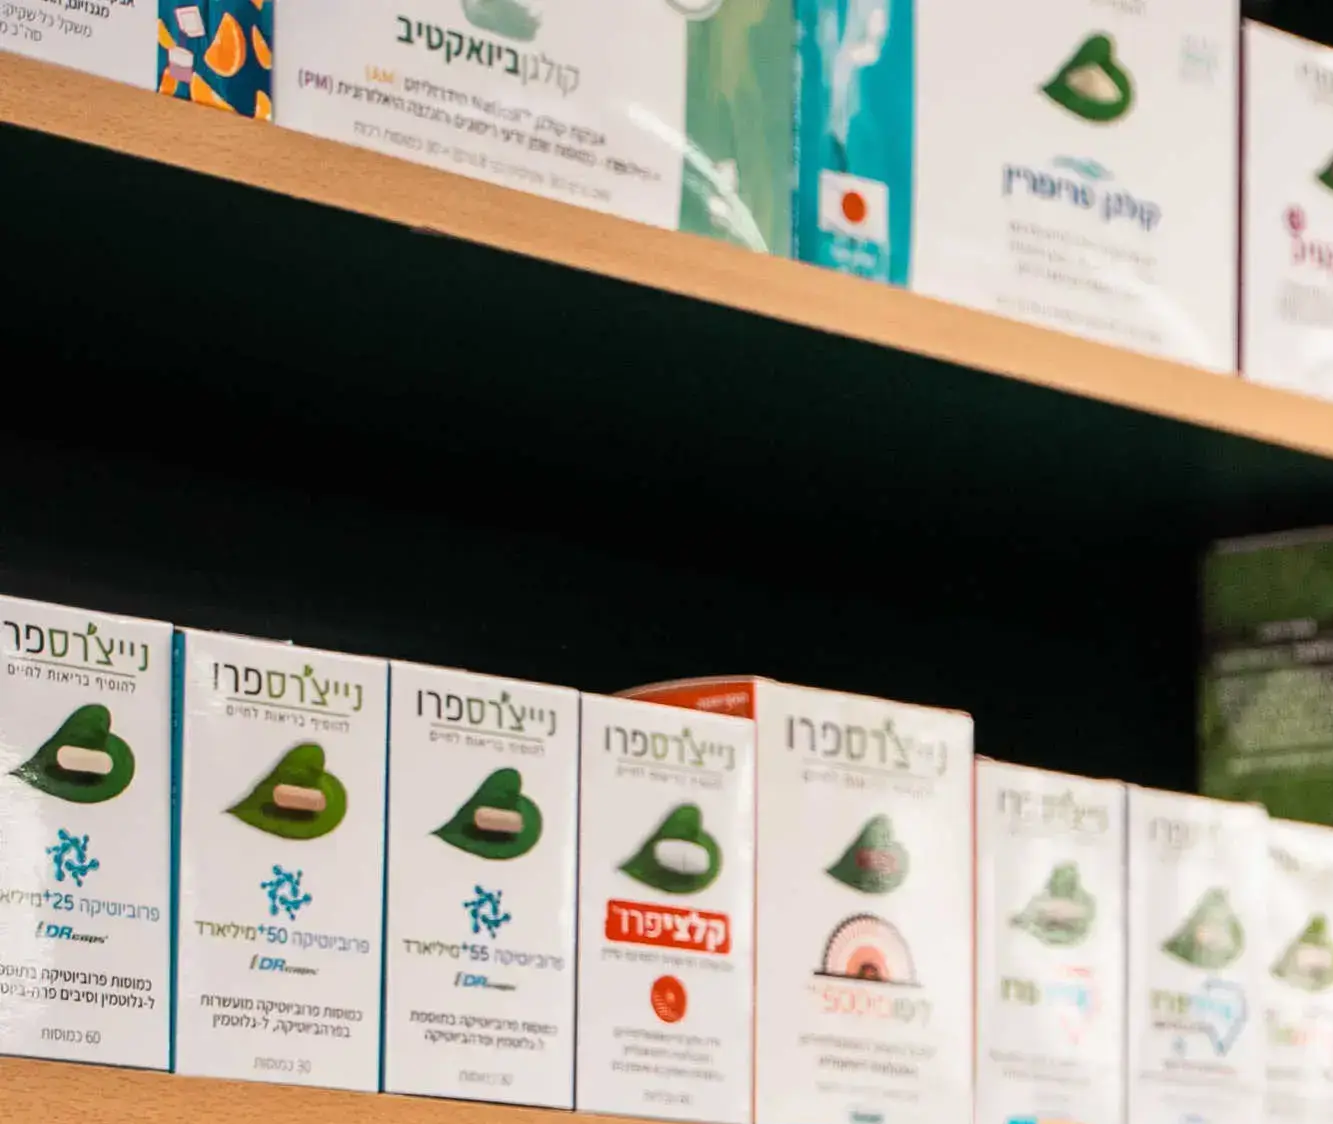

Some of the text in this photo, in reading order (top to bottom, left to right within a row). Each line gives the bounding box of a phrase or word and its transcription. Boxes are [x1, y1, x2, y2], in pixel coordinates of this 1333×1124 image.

[298, 68, 334, 96] (PM)
[3, 622, 149, 672] נייצ'רספר
[7, 663, 136, 693] להוסיף בריאות לחיים
[79, 897, 161, 923] פרוביוטיקה
[291, 930, 370, 954] פרוביוטיקה
[41, 967, 108, 986] פרוביוטיקה
[110, 975, 153, 992] כמוסות
[60, 987, 98, 1004] וסיבים
[256, 999, 320, 1018] פרוביוטיקה
[322, 1006, 364, 1022] כמוסות
[41, 1027, 101, 1044] 60 כמוסות
